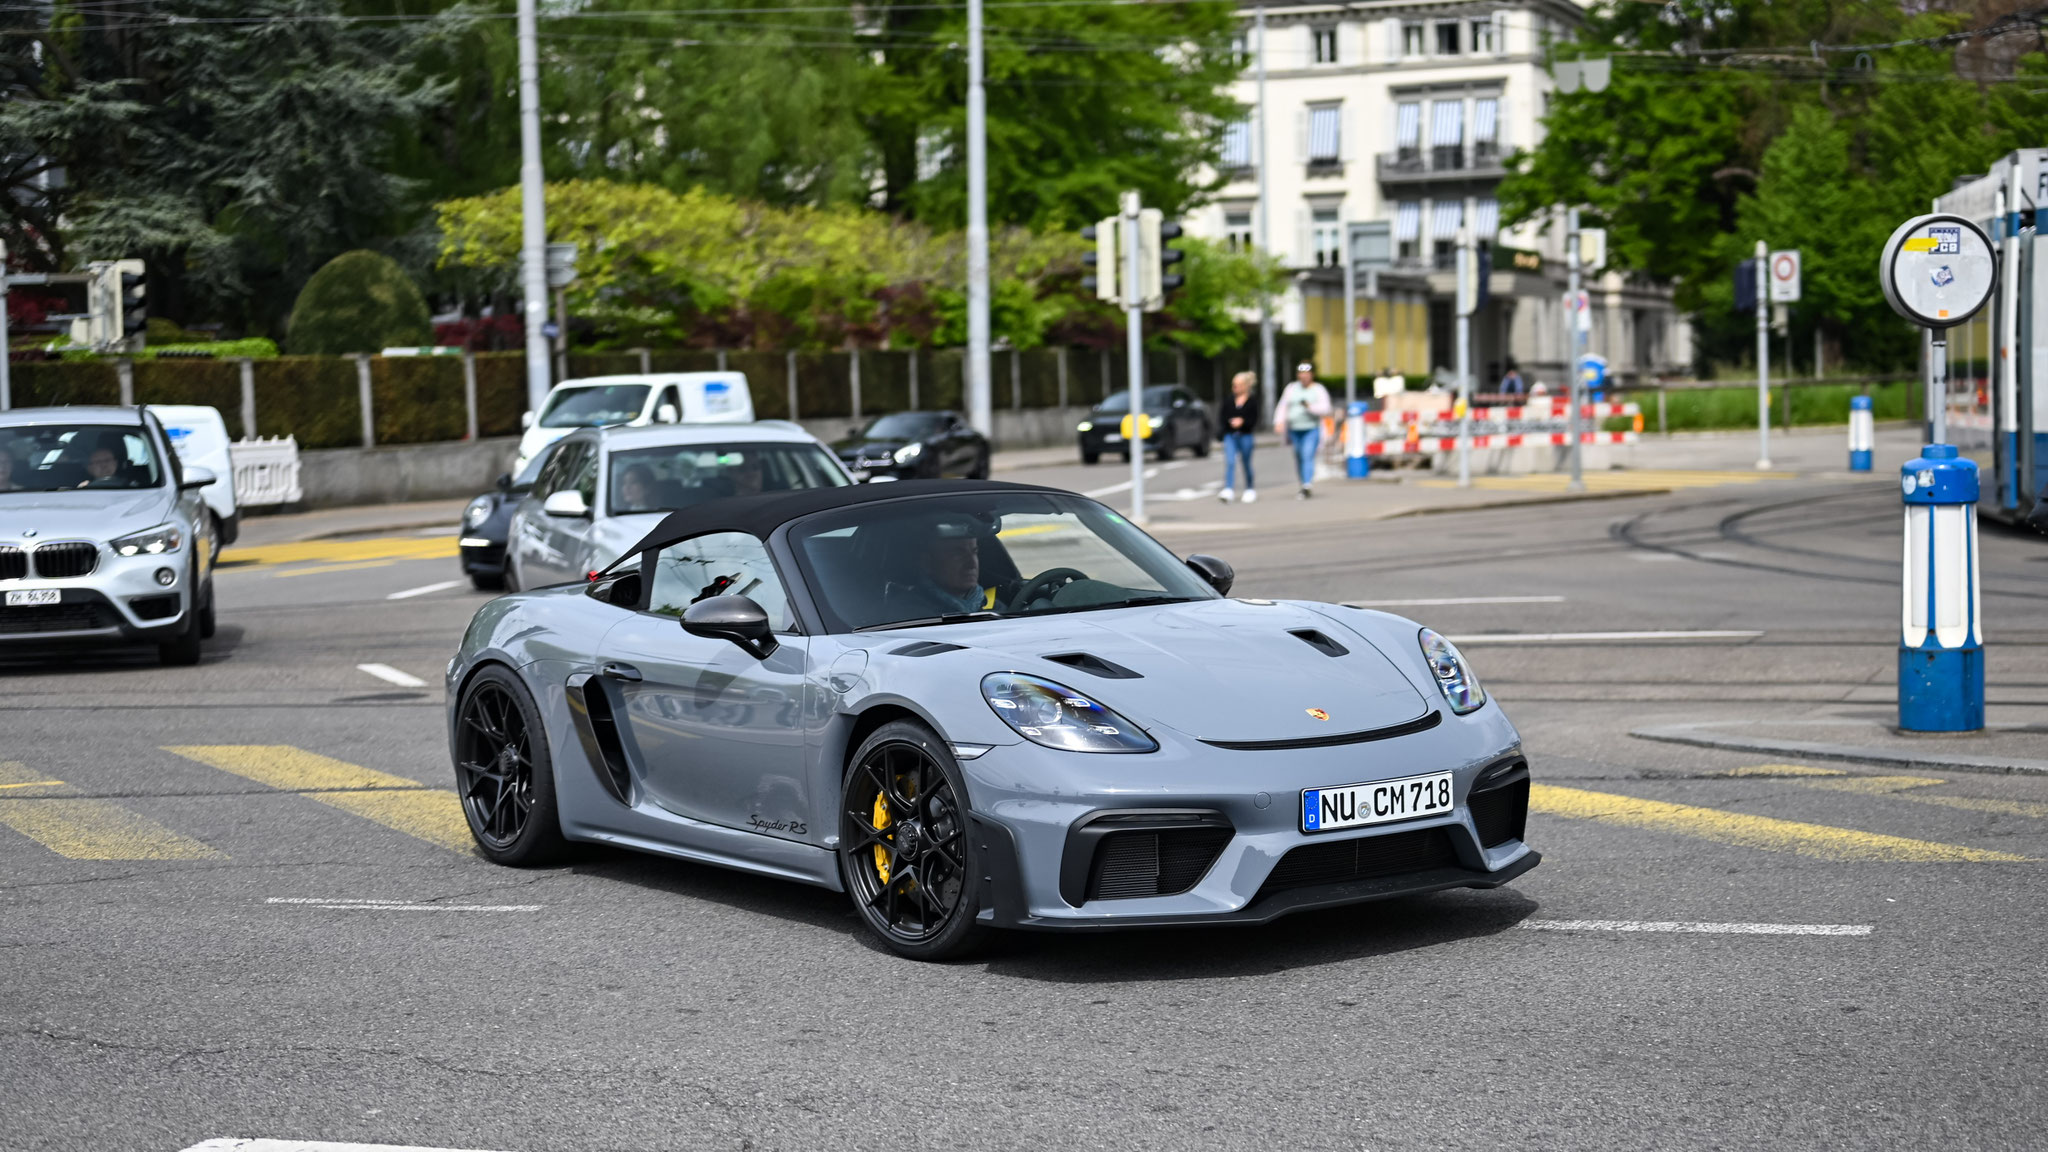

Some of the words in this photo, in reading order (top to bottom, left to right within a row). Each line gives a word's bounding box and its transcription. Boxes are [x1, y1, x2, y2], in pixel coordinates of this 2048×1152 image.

[1308, 814, 1316, 823] D
[1321, 791, 1356, 824] NU
[1374, 783, 1405, 817] CM
[1410, 778, 1450, 812] 718
[745, 814, 788, 833] Spyder
[789, 821, 808, 835] RS
